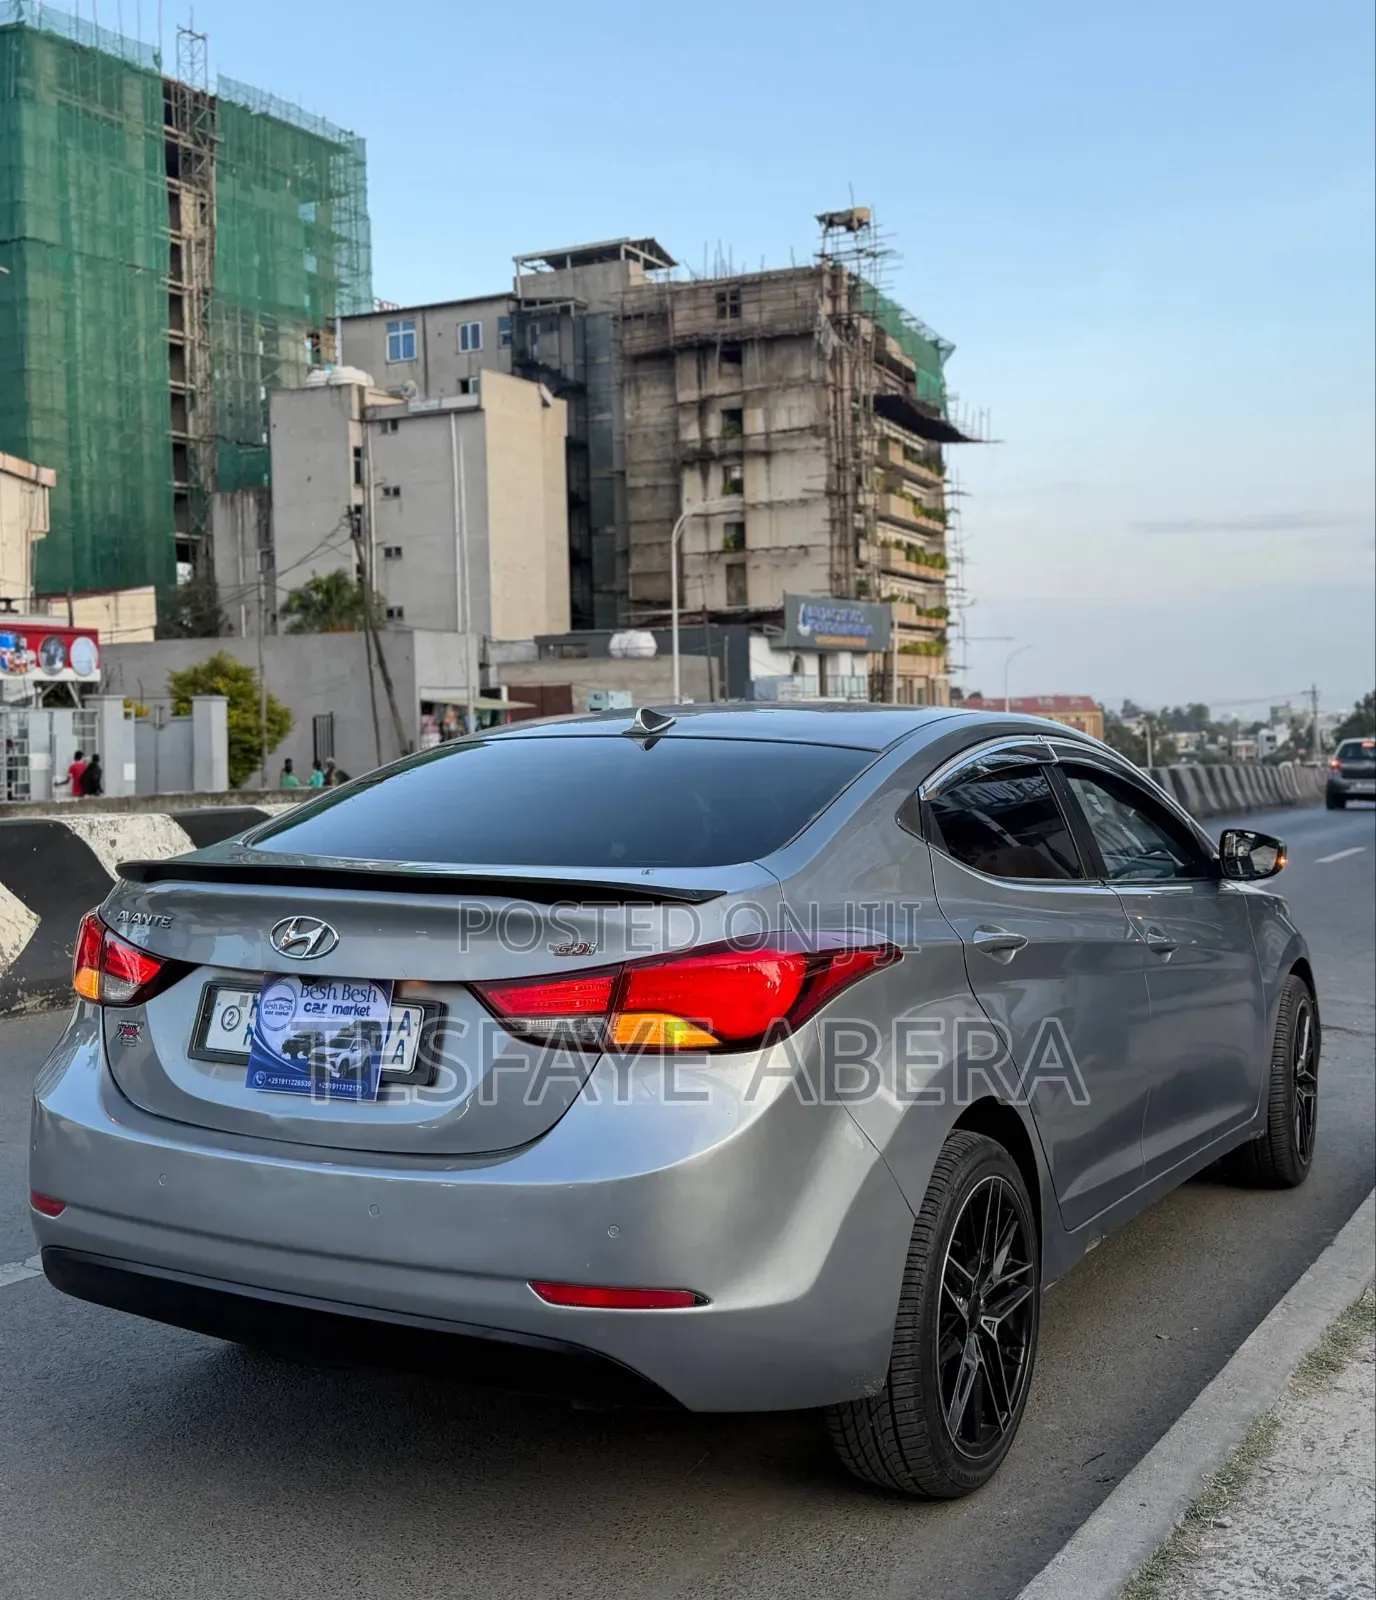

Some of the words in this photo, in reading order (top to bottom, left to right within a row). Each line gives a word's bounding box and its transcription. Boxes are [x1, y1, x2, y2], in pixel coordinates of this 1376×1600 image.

[117, 910, 174, 929] AVANTE
[553, 941, 598, 957] GDi
[299, 983, 338, 1001] Besh
[341, 983, 378, 1003] Besh
[303, 1002, 328, 1014] car
[331, 1003, 371, 1017] market
[396, 1009, 412, 1037] A
[391, 1038, 405, 1065] A
